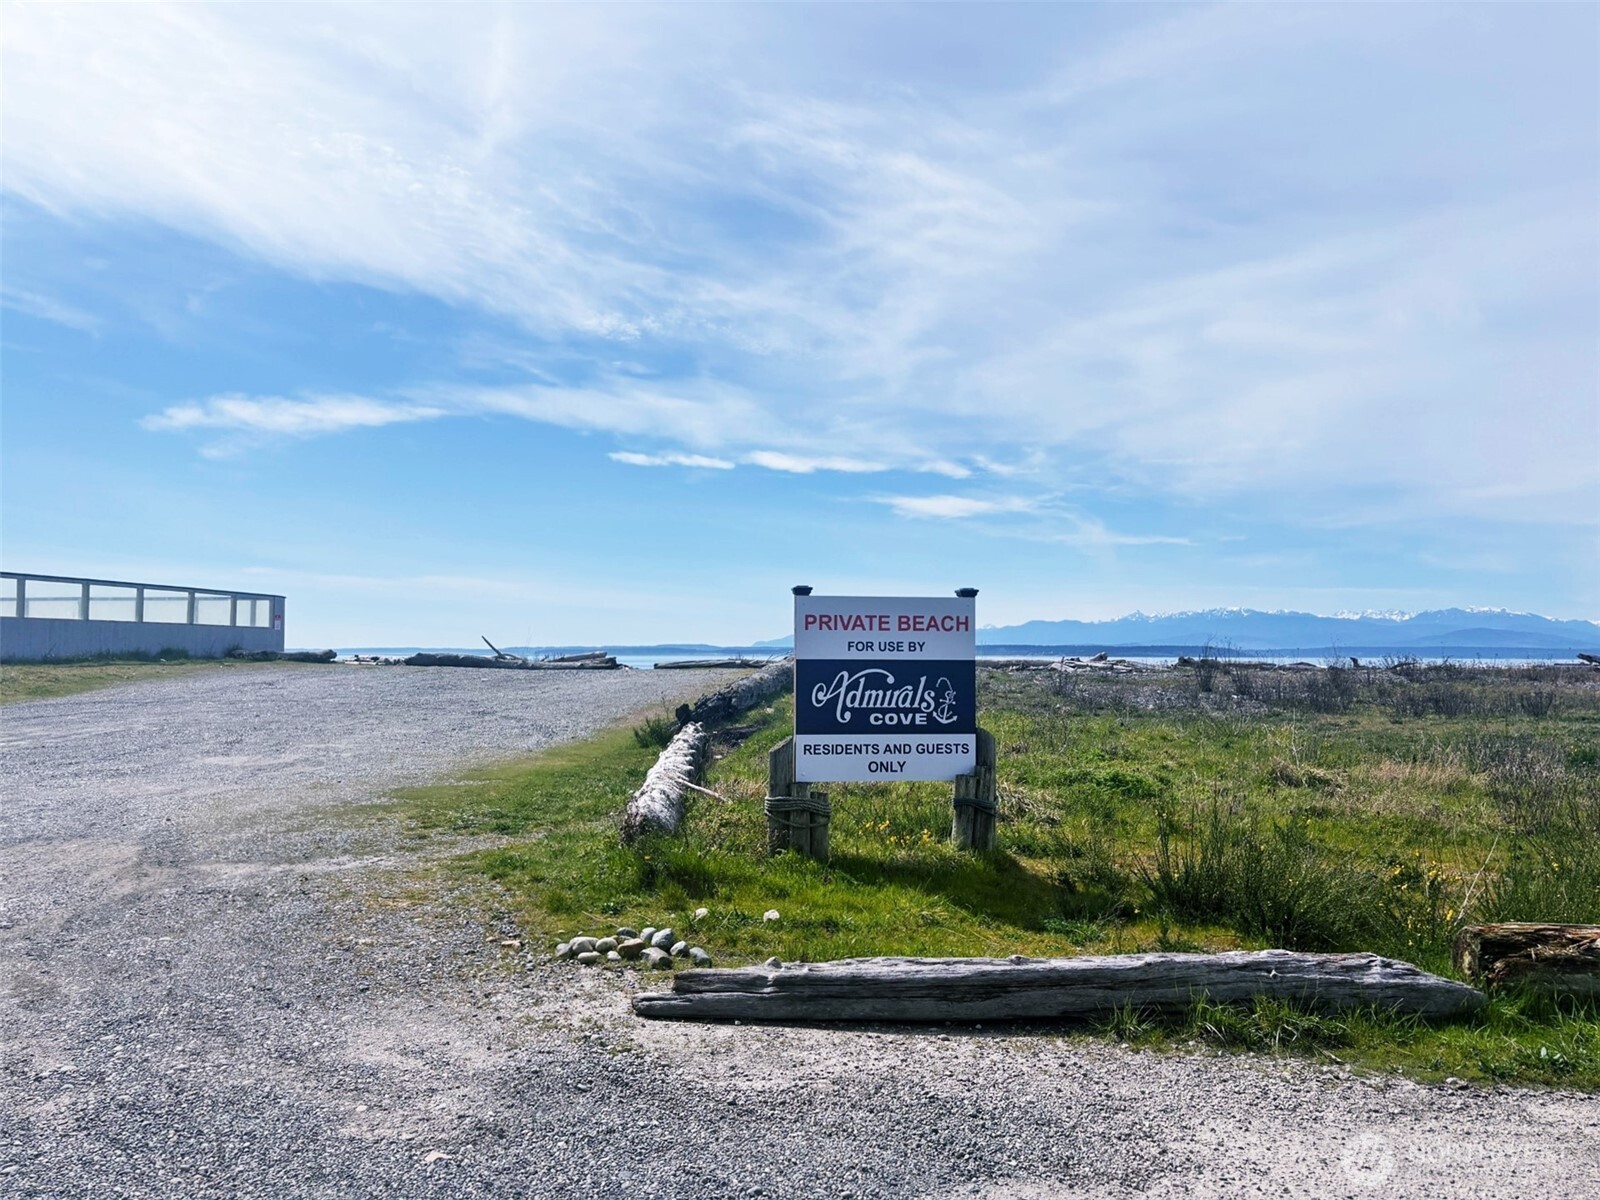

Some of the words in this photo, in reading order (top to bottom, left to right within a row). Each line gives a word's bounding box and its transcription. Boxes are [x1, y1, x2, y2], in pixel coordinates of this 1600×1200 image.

[804, 614, 890, 631] PRIVATE
[897, 615, 969, 632] BEACH
[847, 641, 874, 652] FOR
[878, 641, 904, 652] USE
[908, 641, 926, 652] BY
[811, 668, 935, 723] Admirals
[869, 713, 928, 725] COVE
[803, 744, 880, 755] RESIDENTS
[883, 743, 912, 755] AND
[915, 743, 970, 755] GUESTS
[868, 761, 906, 772] ONLY
